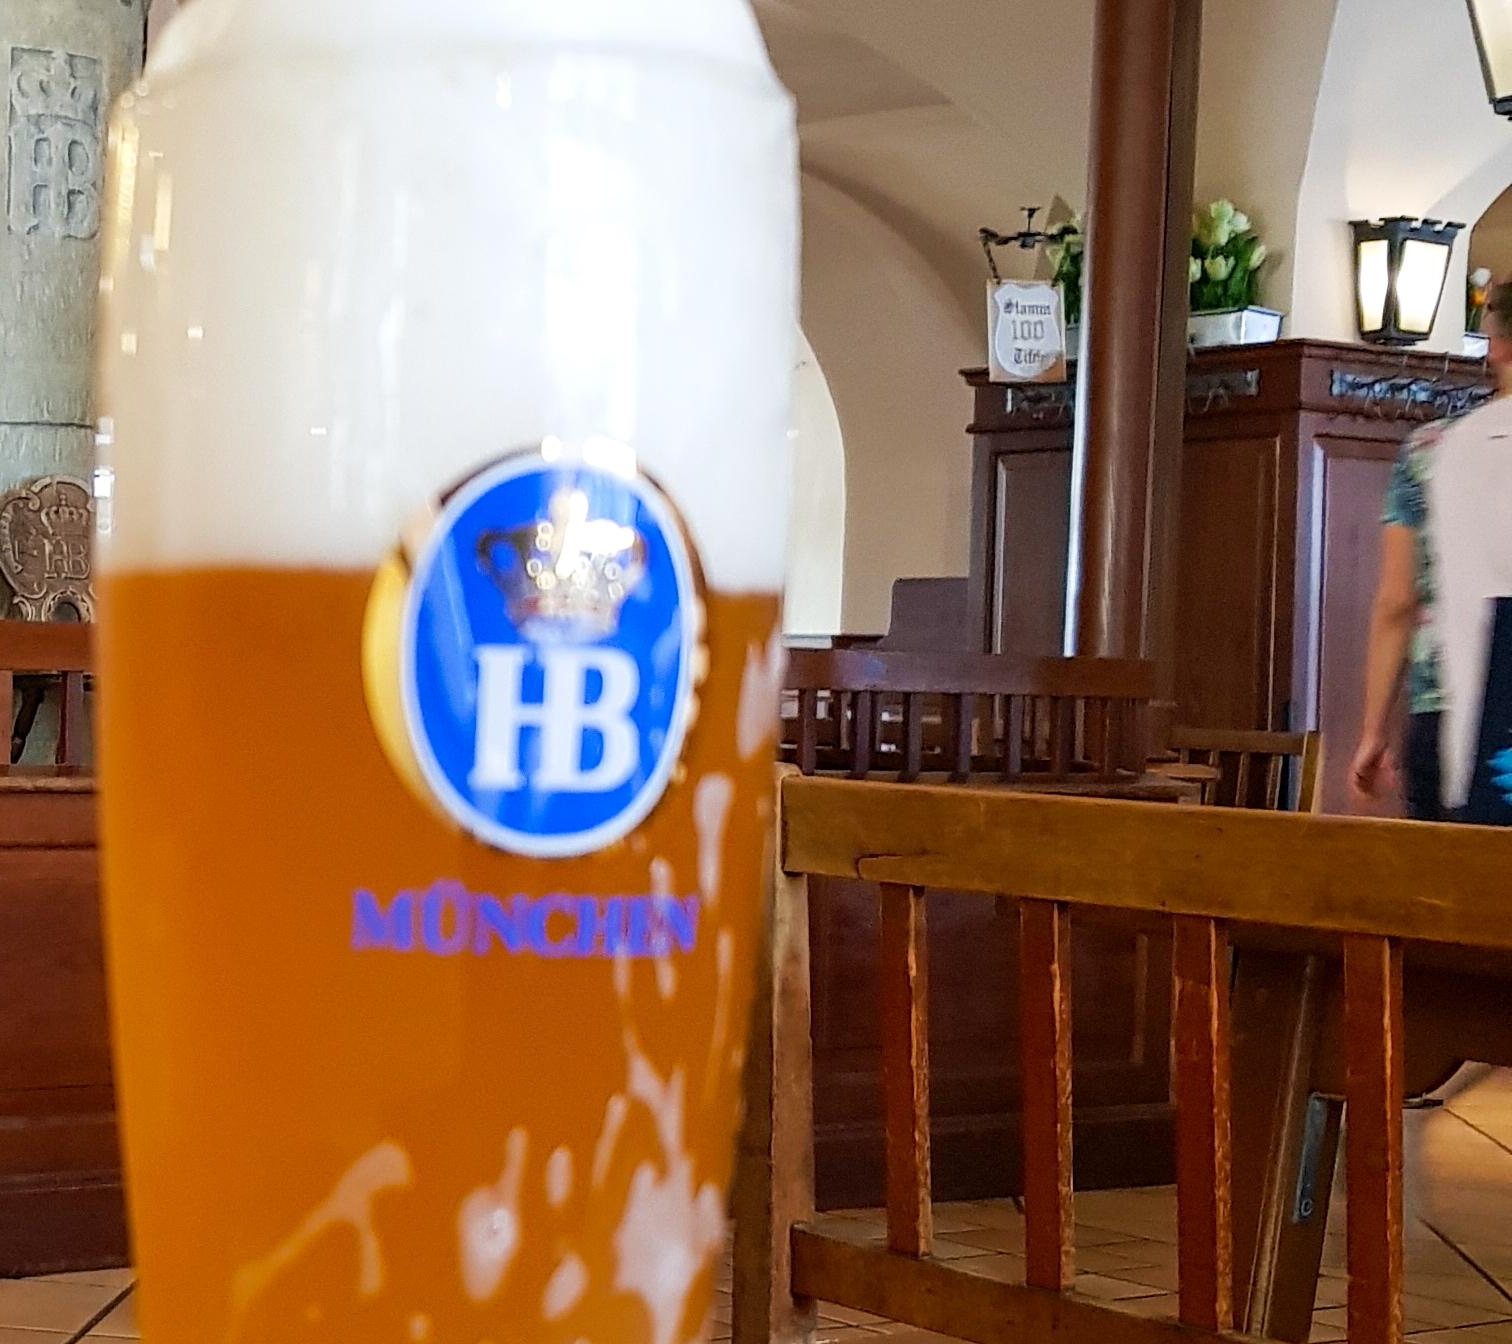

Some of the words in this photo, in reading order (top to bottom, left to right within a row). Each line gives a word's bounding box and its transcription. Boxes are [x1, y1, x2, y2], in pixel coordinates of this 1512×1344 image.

[1011, 320, 1045, 341] 100
[467, 642, 641, 794] HB
[351, 877, 701, 958] MÜNCHEN
